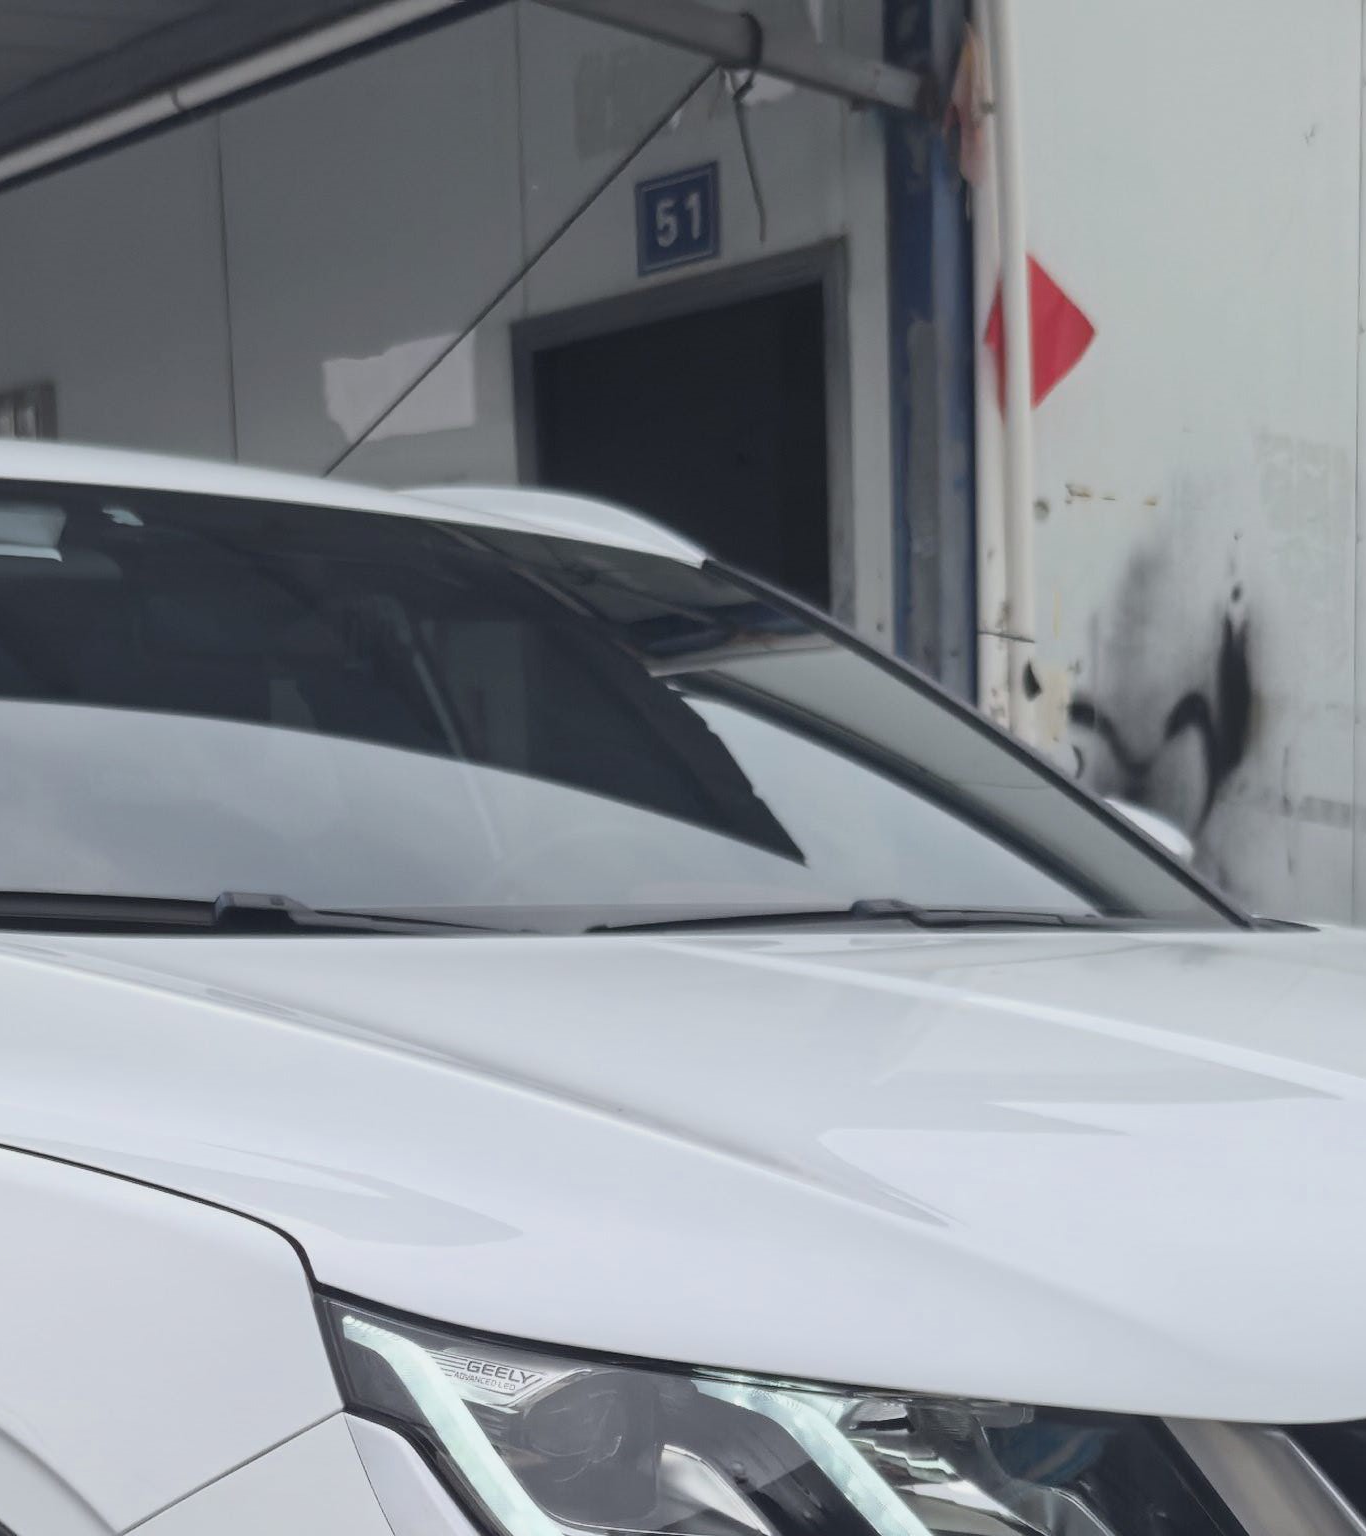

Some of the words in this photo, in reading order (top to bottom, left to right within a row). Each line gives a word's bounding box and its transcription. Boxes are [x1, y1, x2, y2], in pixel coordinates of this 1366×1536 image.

[656, 192, 701, 248] 51
[453, 1371, 497, 1387] ADVANCED
[498, 1382, 516, 1392] LED
[466, 1360, 537, 1385] GEELY
